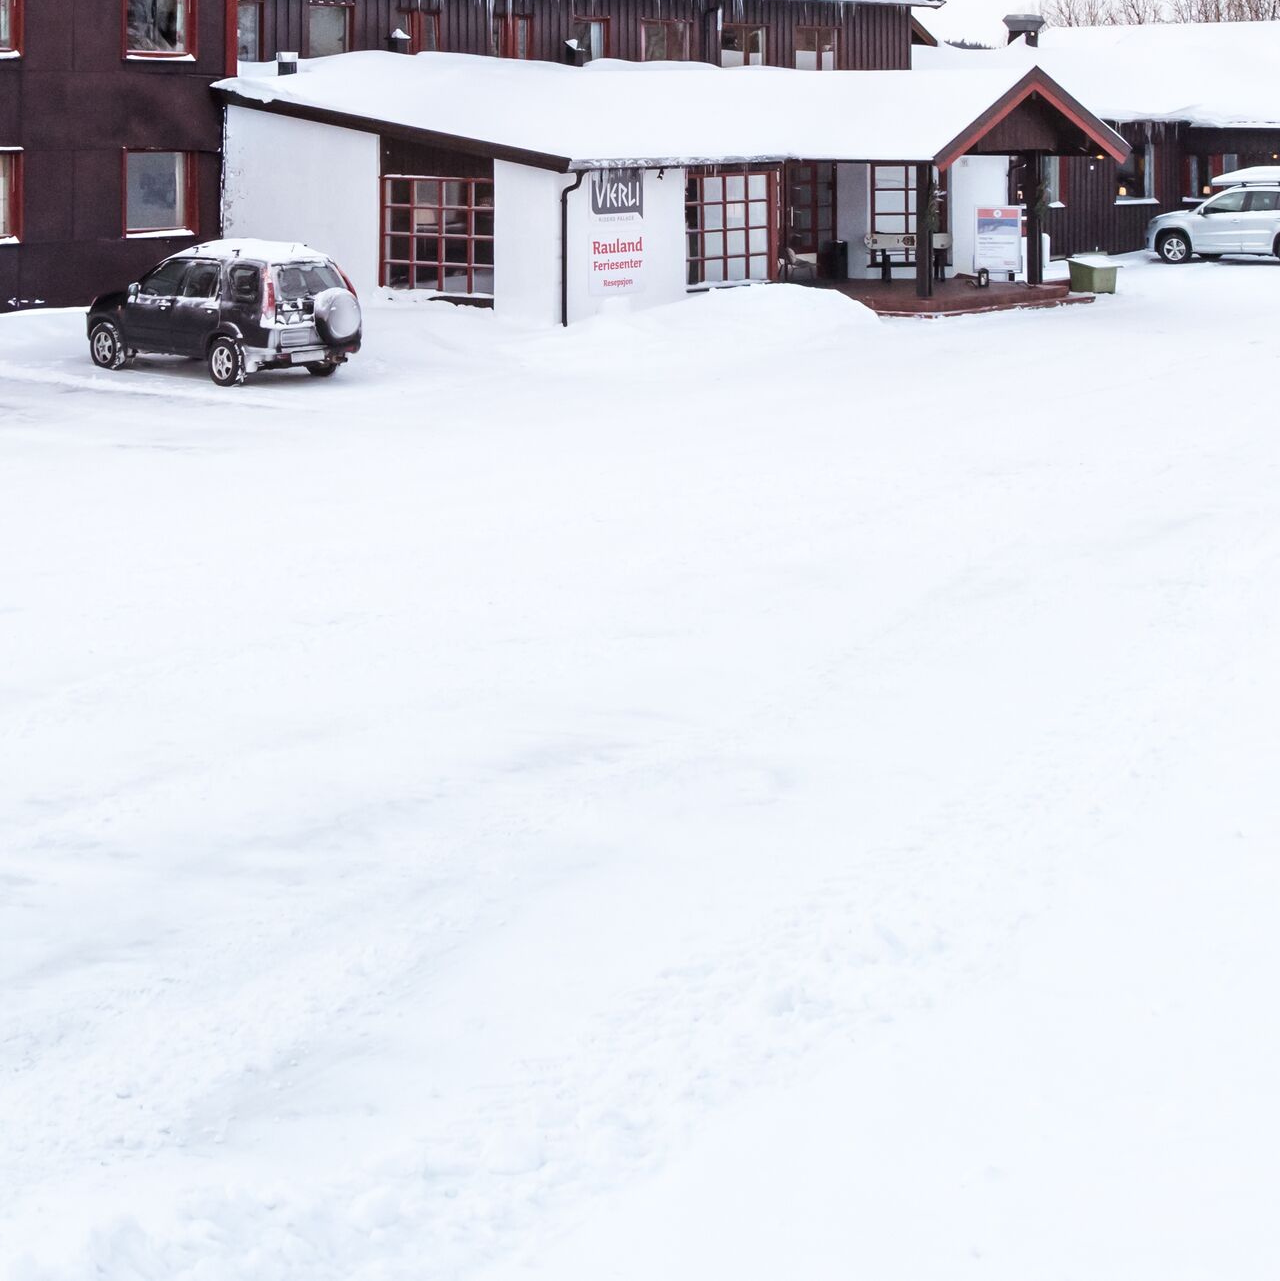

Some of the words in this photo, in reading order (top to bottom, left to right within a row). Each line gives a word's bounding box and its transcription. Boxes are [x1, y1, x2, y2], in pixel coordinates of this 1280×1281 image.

[595, 180, 640, 208] VIERLI
[592, 236, 643, 255] Rauland
[593, 258, 643, 271] Feriesenter
[603, 277, 633, 287] Resepsjon
